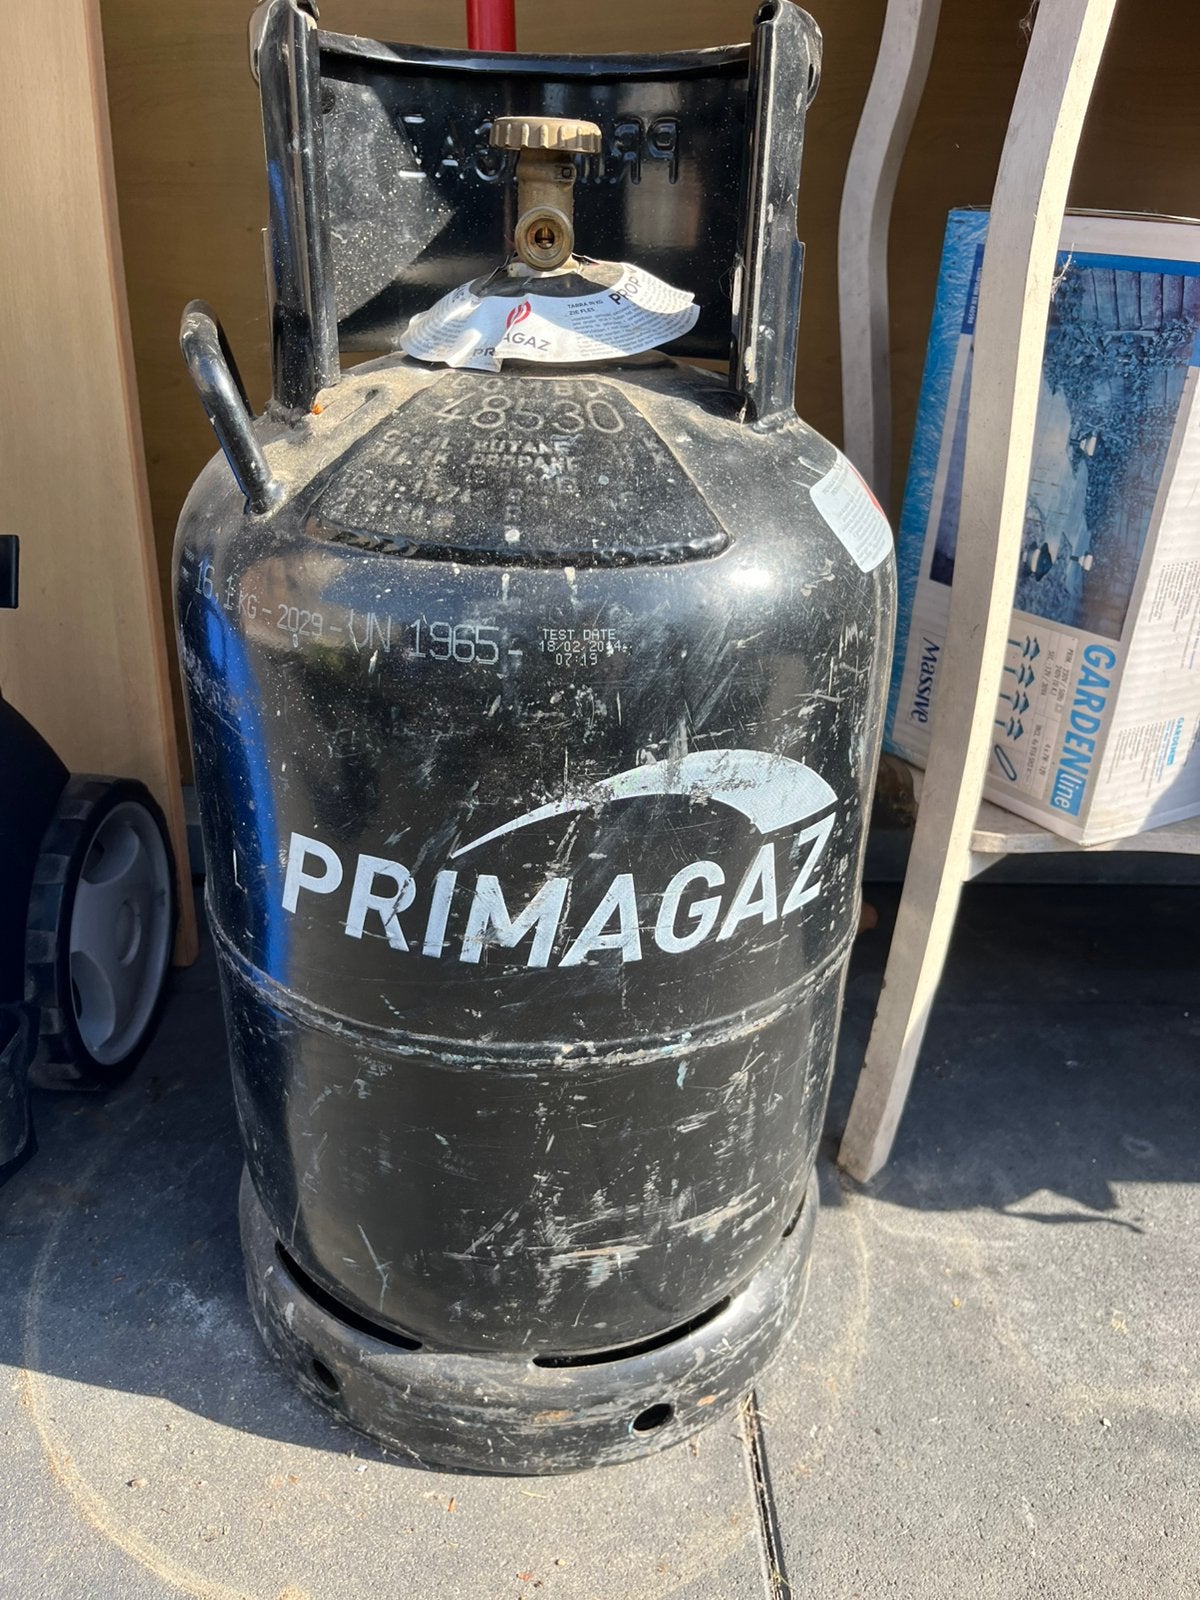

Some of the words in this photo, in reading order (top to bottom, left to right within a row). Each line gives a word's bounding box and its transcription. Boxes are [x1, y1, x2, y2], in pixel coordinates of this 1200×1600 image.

[435, 391, 626, 434] 48530
[237, 589, 258, 620] KG
[276, 603, 324, 637] 2029
[410, 618, 500, 666] 1965
[542, 628, 575, 640] TEST
[583, 628, 617, 640] DATE
[555, 653, 598, 666] 07:19
[912, 637, 941, 723] Massive
[282, 812, 837, 968] PRIMAGAZ
